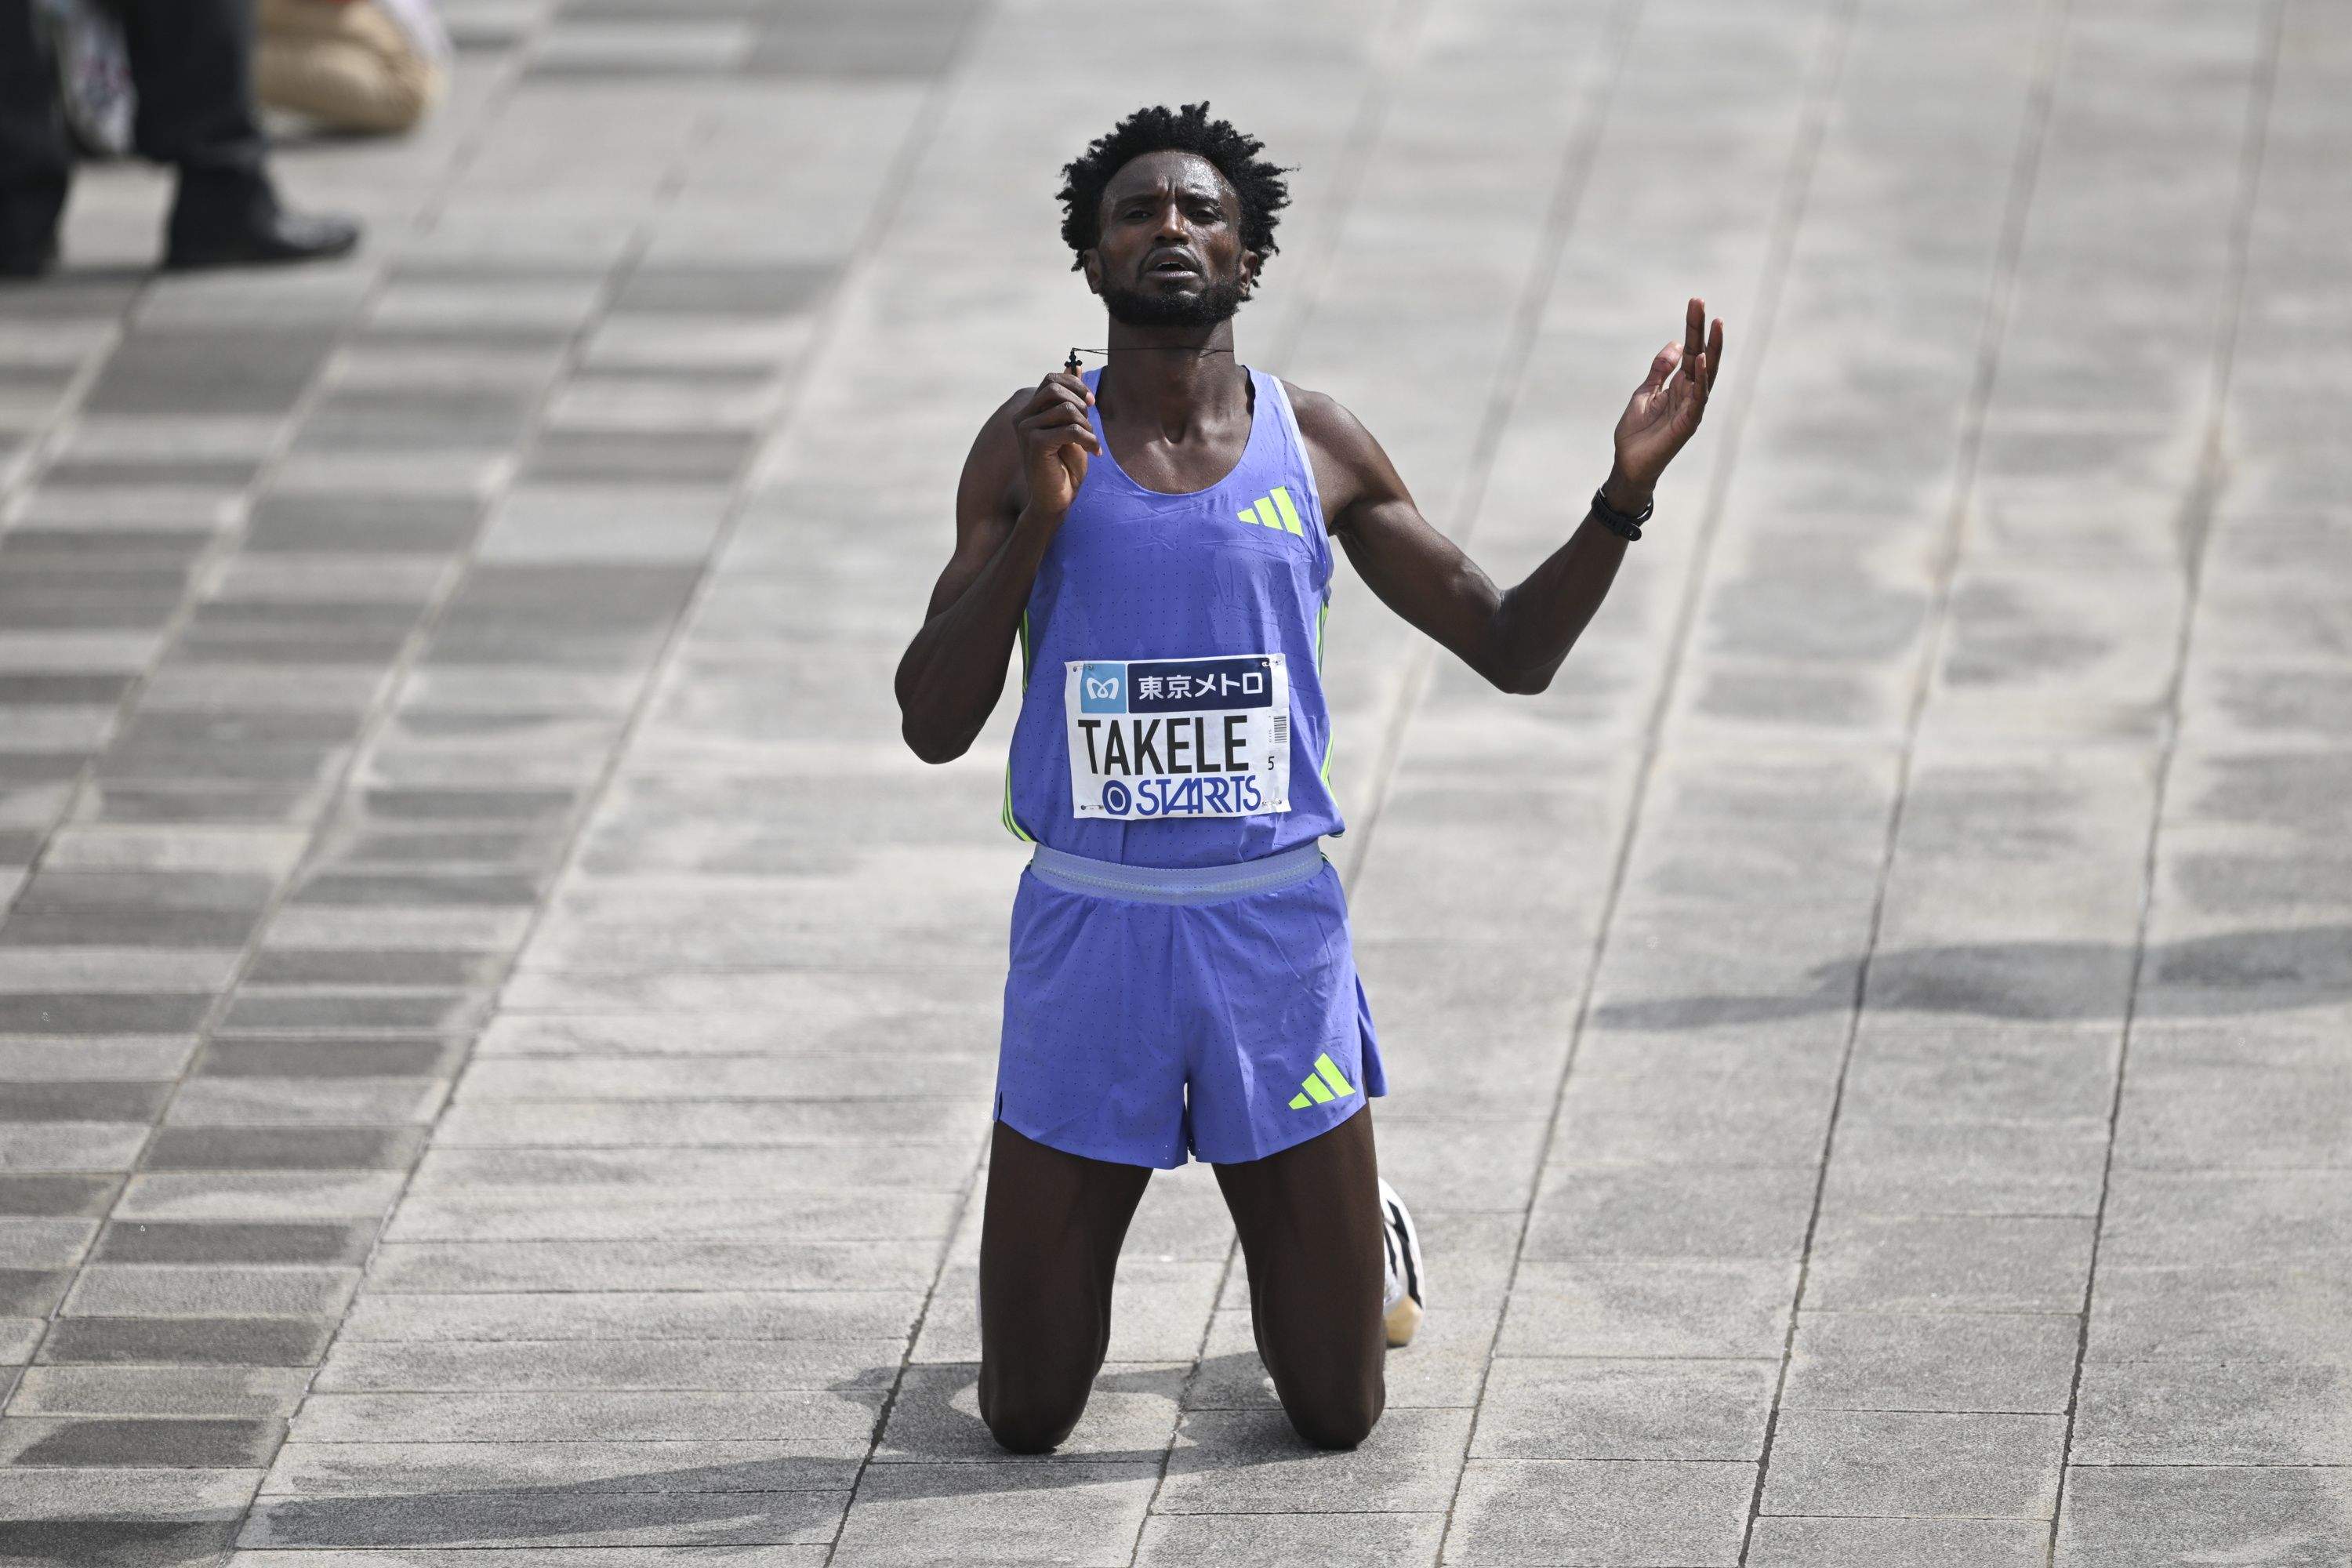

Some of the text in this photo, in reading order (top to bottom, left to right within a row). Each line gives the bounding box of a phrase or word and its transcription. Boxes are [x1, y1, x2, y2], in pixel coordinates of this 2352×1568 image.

[1138, 672, 1263, 700] 東京メトロ
[1078, 714, 1249, 775] TAKELE
[1268, 756, 1275, 770] 5
[1136, 775, 1261, 816] STARTS
